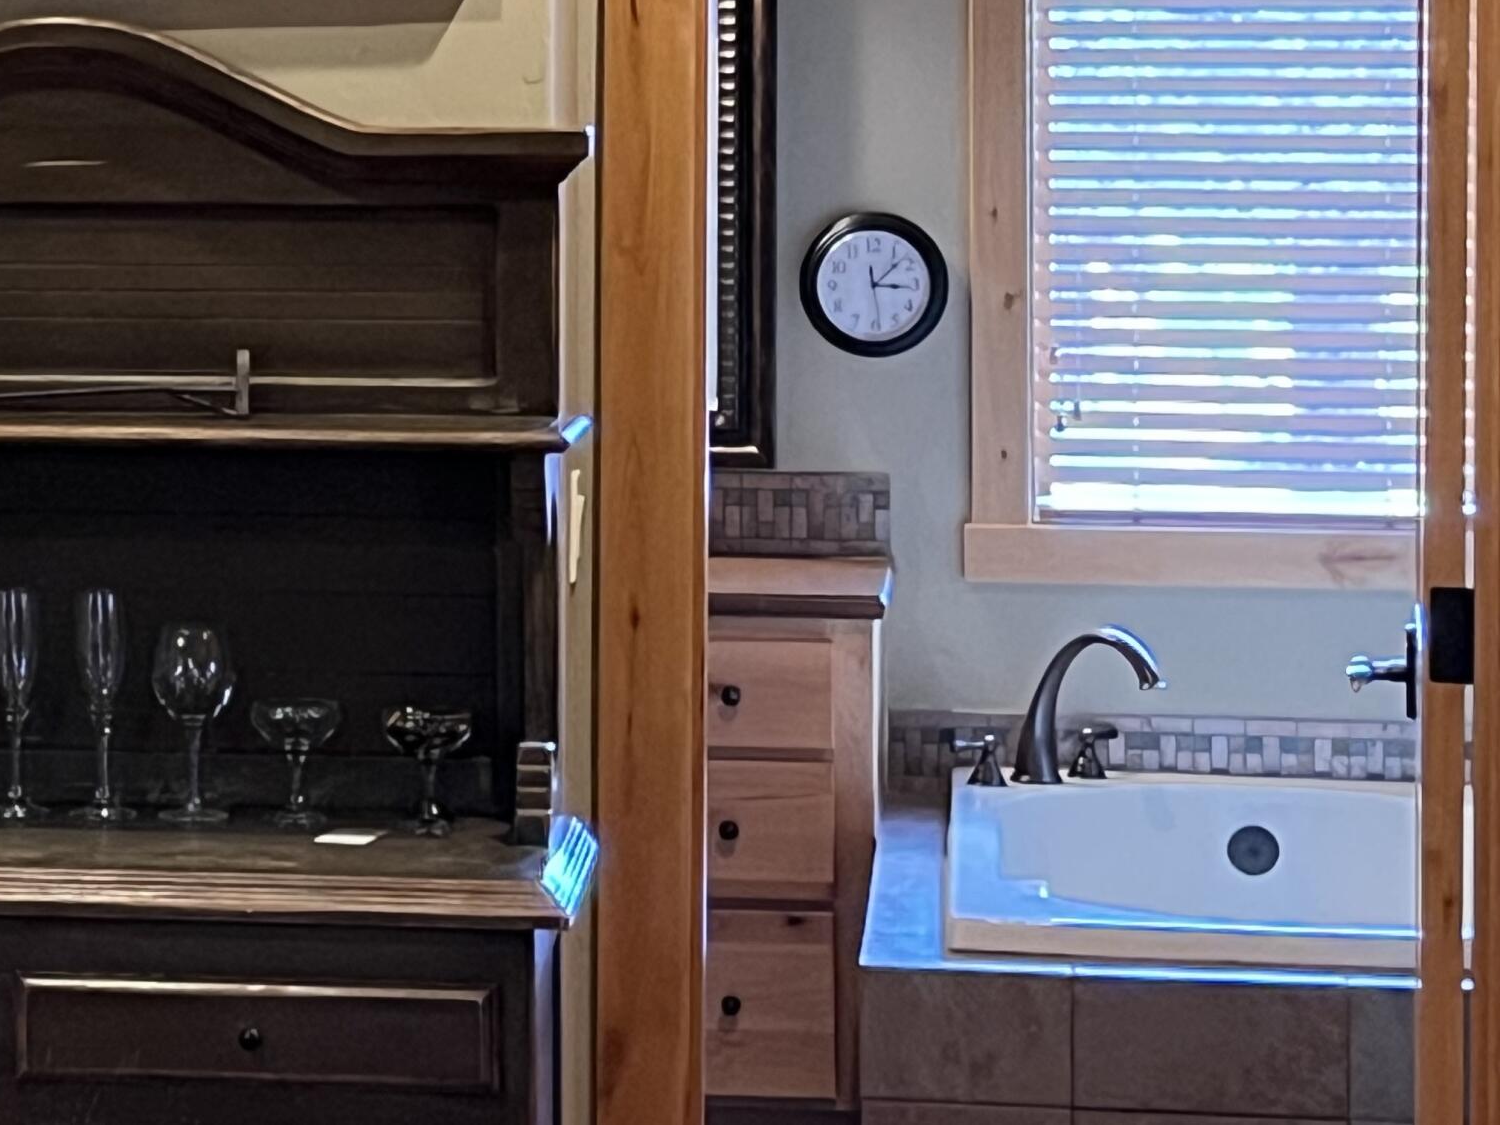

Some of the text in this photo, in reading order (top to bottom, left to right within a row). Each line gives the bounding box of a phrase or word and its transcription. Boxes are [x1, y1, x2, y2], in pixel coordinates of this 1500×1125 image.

[867, 237, 881, 252] 12
[832, 259, 846, 274] 10
[827, 279, 838, 292] 9
[851, 313, 860, 329] 7
